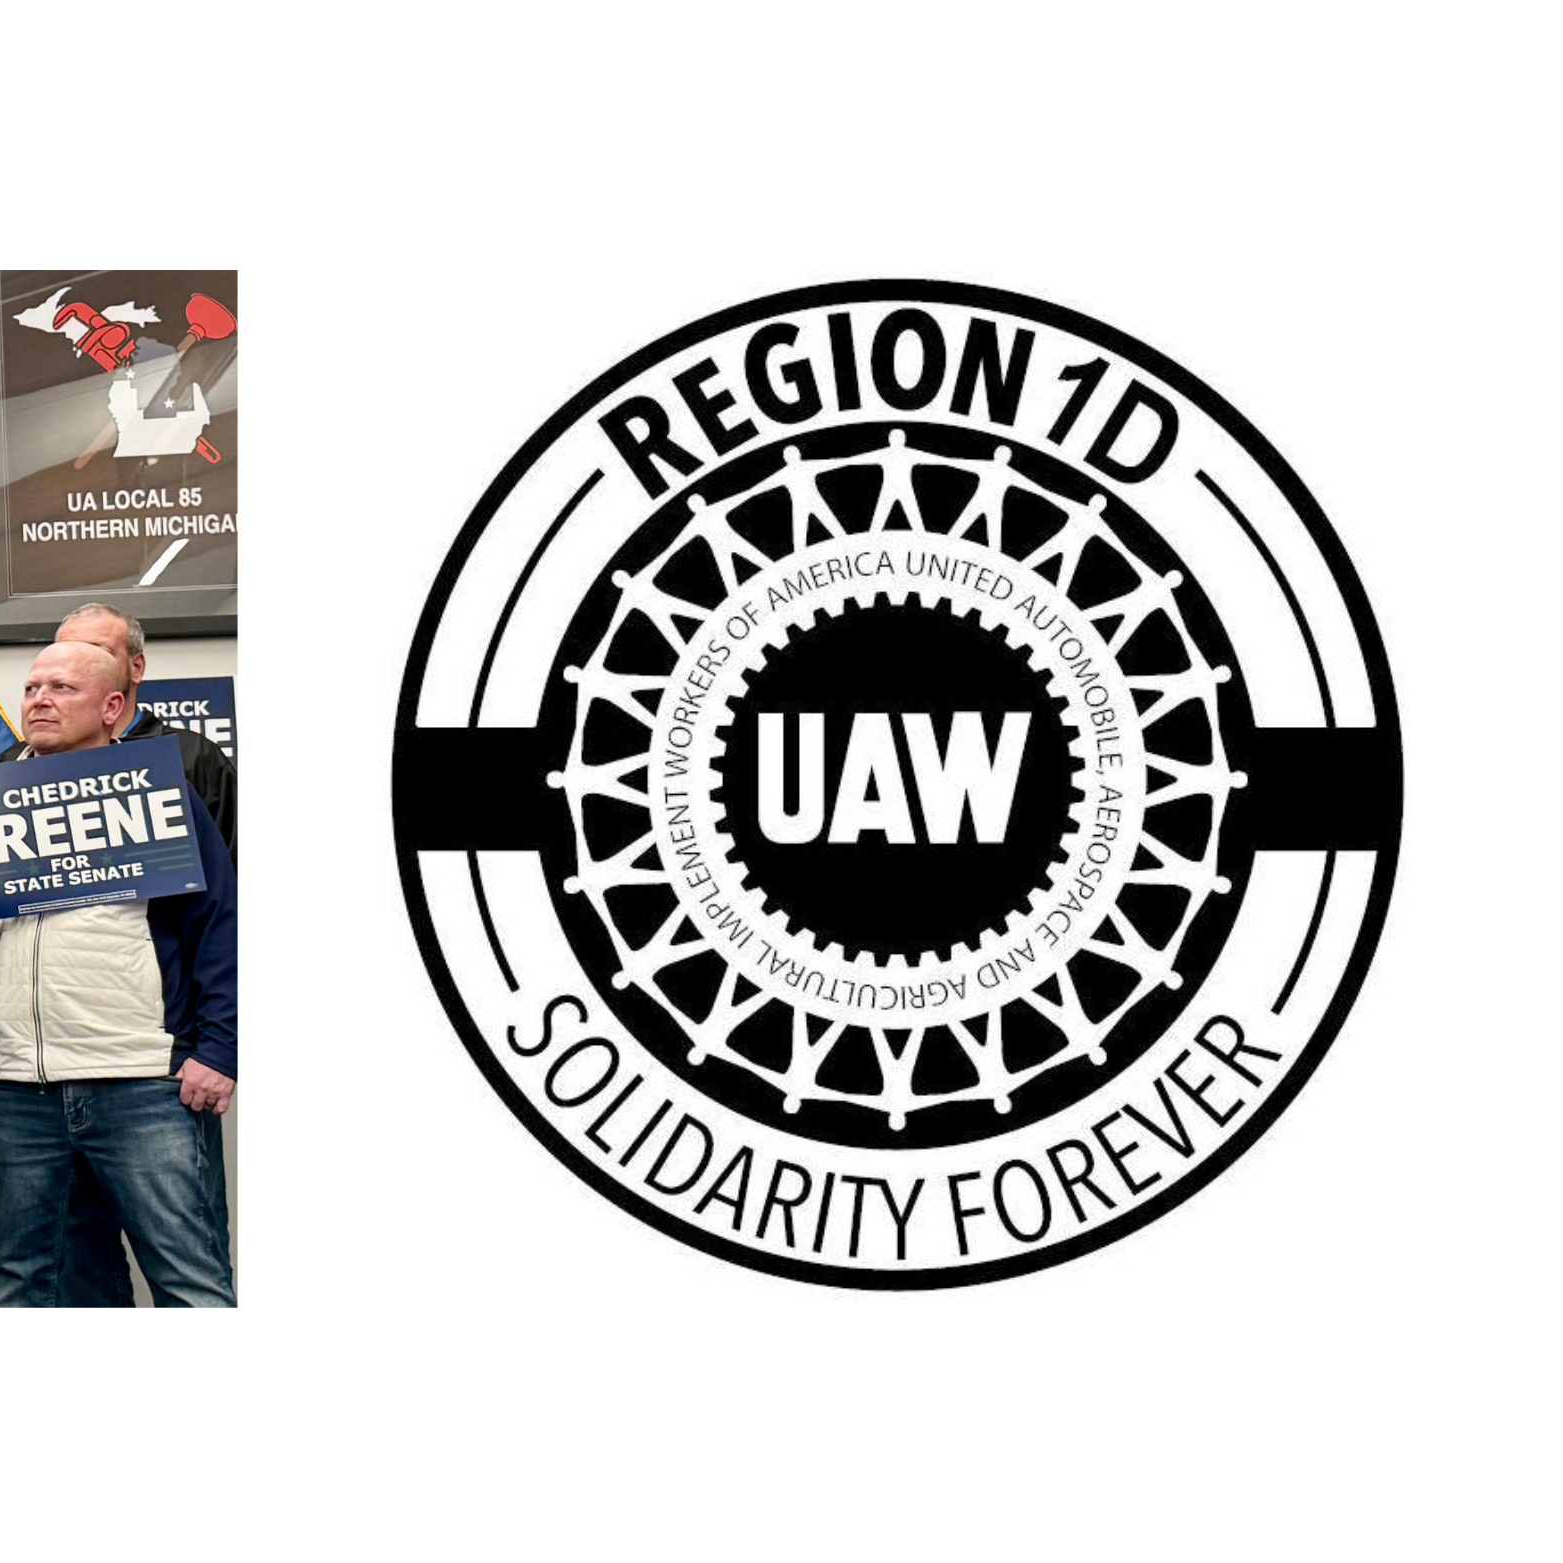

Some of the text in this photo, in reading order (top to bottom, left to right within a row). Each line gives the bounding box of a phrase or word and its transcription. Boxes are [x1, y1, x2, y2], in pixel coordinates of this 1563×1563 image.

[67, 487, 202, 512] UA LOCAL 85
[22, 518, 139, 543] NORTHERN
[2, 768, 152, 809] CHEDRICK
[51, 854, 91, 872] FOR
[3, 862, 144, 895] STATE SENATE
